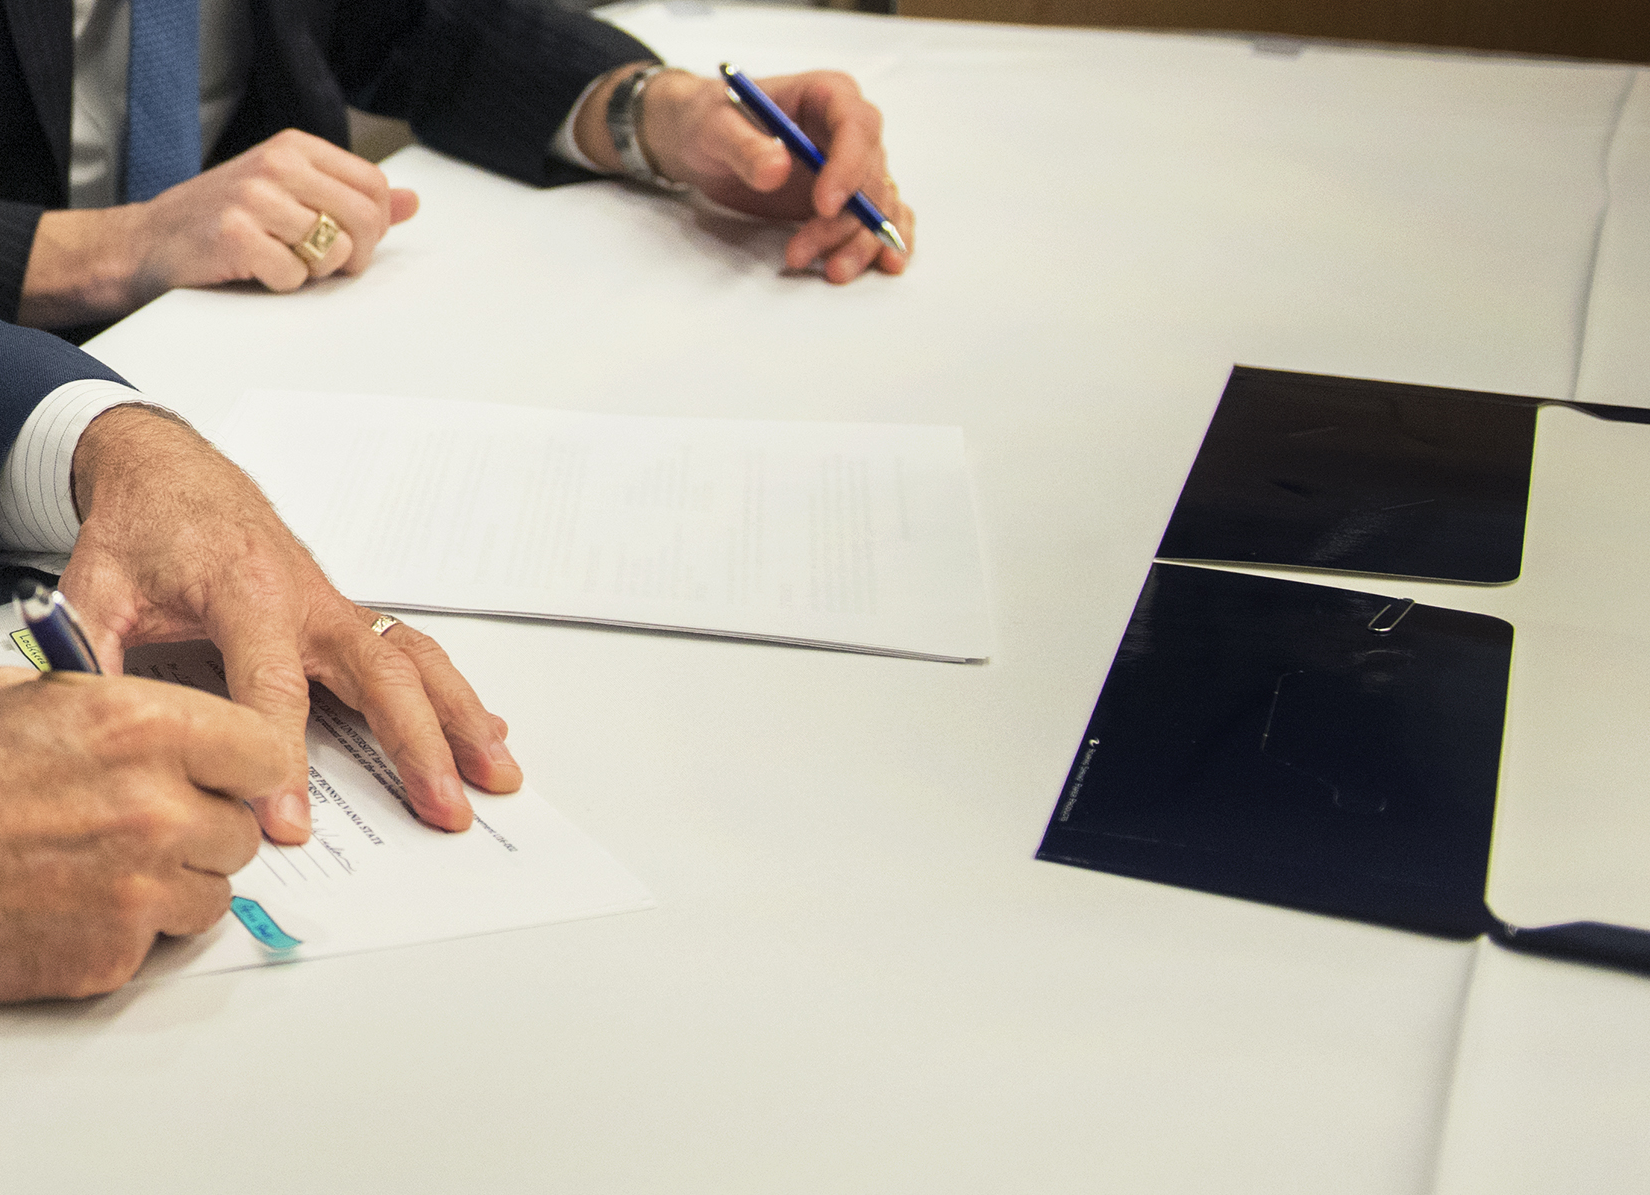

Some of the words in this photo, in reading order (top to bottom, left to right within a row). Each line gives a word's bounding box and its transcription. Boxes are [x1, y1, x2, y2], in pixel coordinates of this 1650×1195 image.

[340, 723, 379, 757] UNIVERSITY
[371, 756, 387, 769] have
[308, 780, 330, 804] ERSITY
[308, 765, 322, 779] THE
[316, 778, 364, 826] PENNSYLVANIA
[358, 824, 386, 846] STATE
